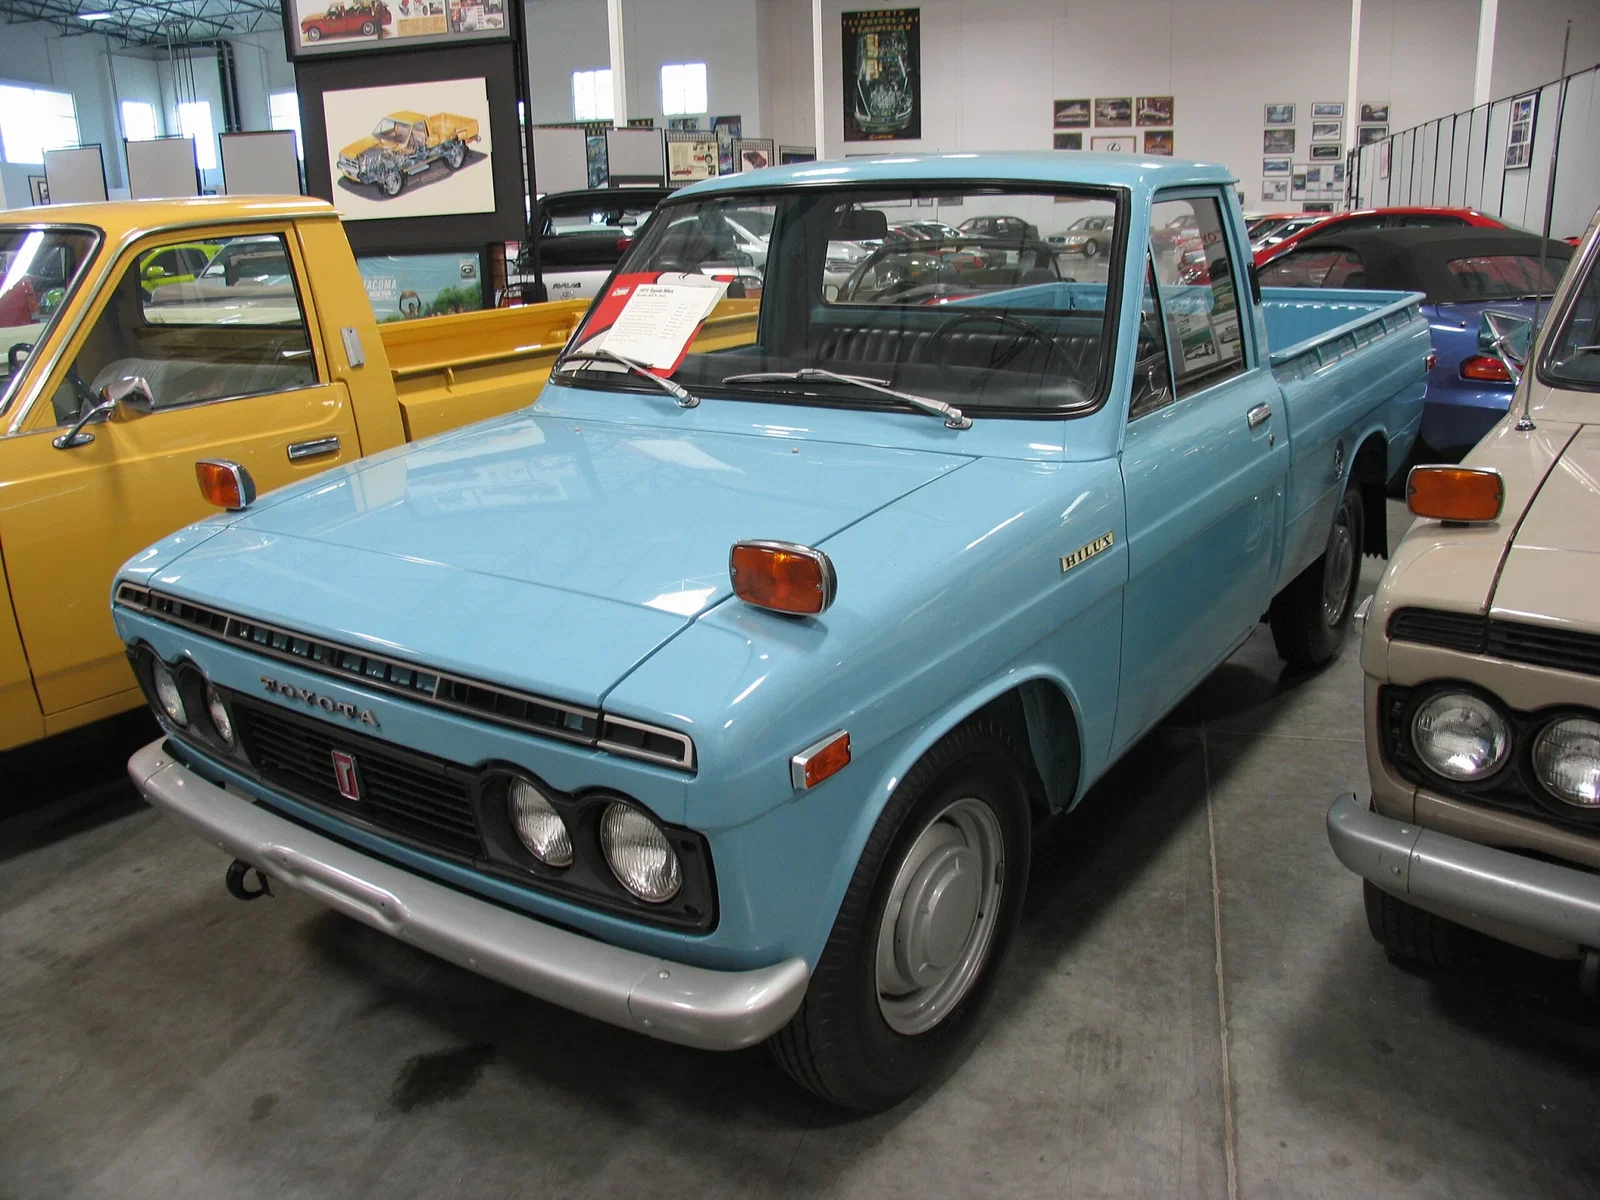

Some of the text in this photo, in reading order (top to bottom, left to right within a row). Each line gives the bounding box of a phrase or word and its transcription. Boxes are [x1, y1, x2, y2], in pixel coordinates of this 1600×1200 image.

[552, 282, 582, 290] RAV4
[1065, 534, 1111, 569] HILUX
[260, 676, 381, 728] TOYOTA
